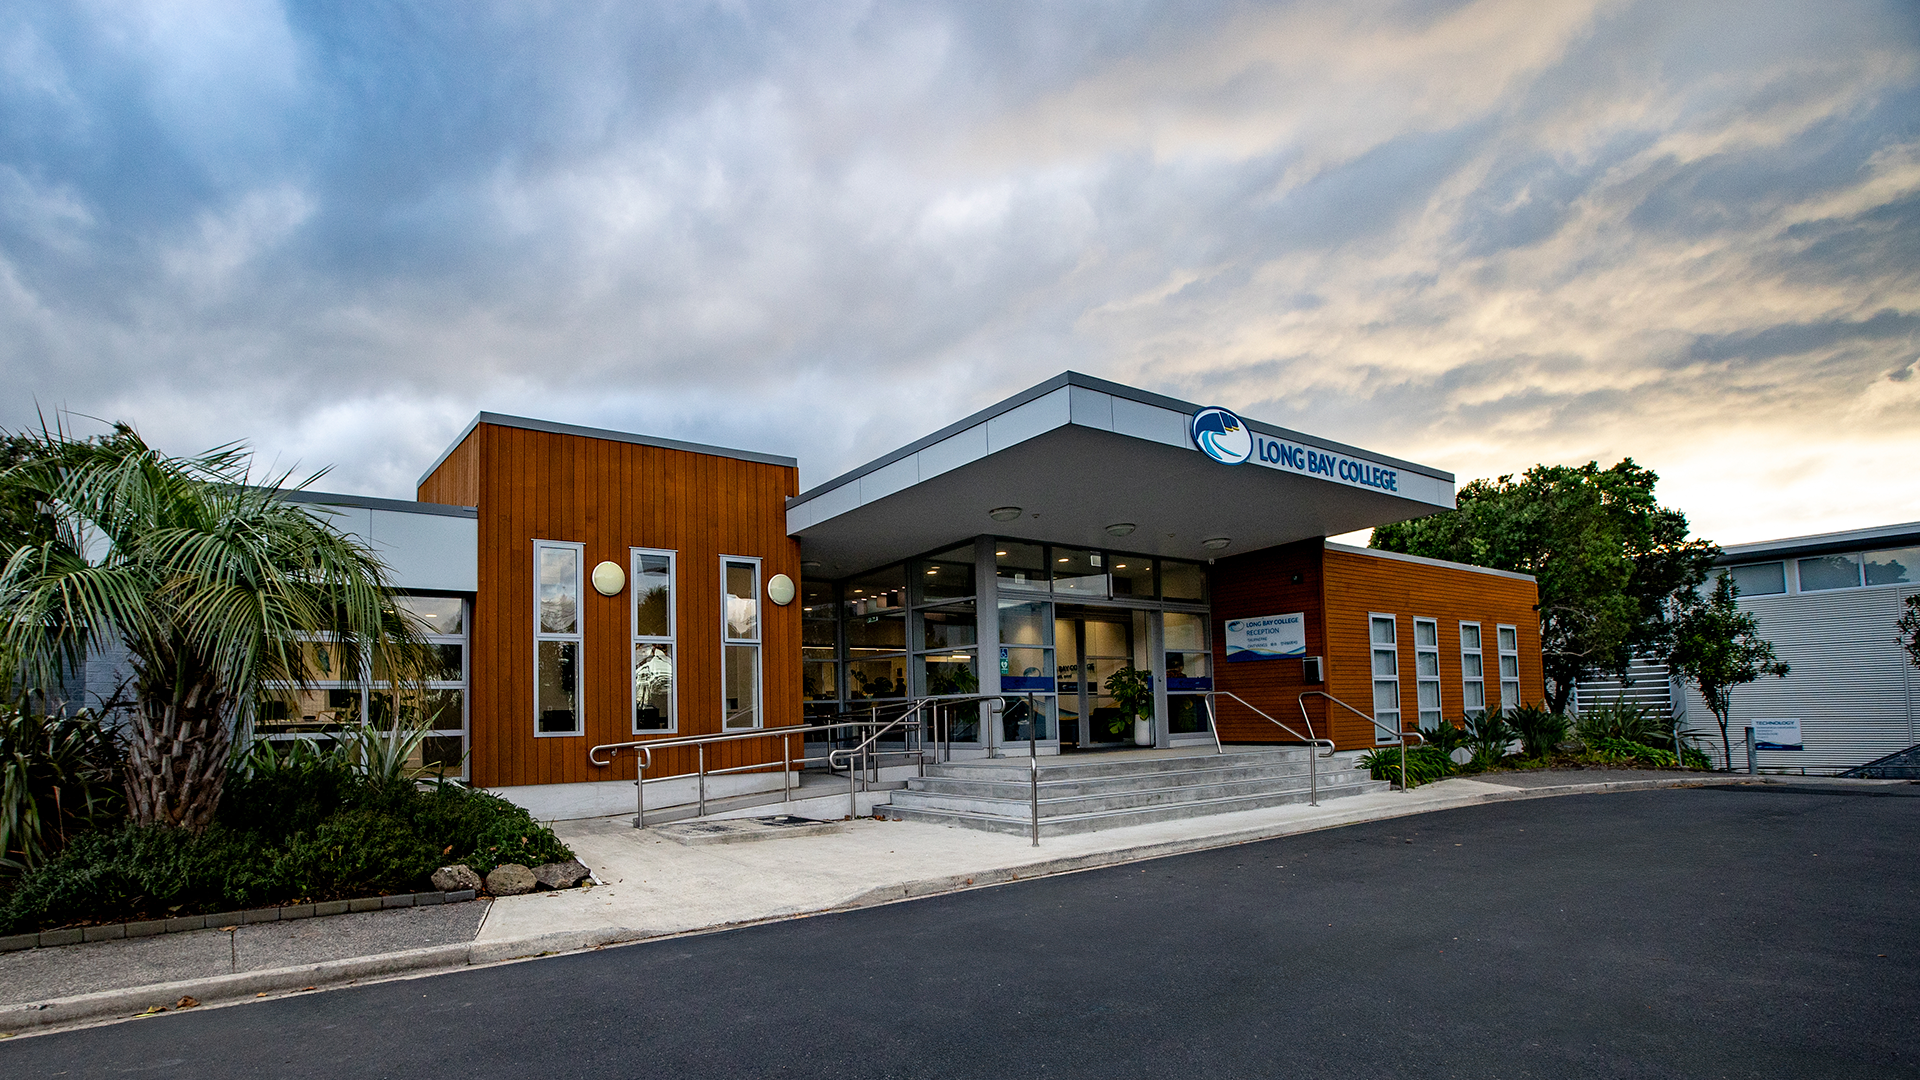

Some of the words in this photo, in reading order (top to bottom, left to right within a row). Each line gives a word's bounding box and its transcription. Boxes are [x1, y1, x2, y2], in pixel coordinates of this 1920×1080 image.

[1259, 438, 1305, 469] LONG
[1308, 451, 1336, 477] BAY
[1338, 459, 1398, 491] COLLEGE
[1274, 617, 1298, 625] COLLEGE
[1246, 628, 1279, 636] RECEPTION
